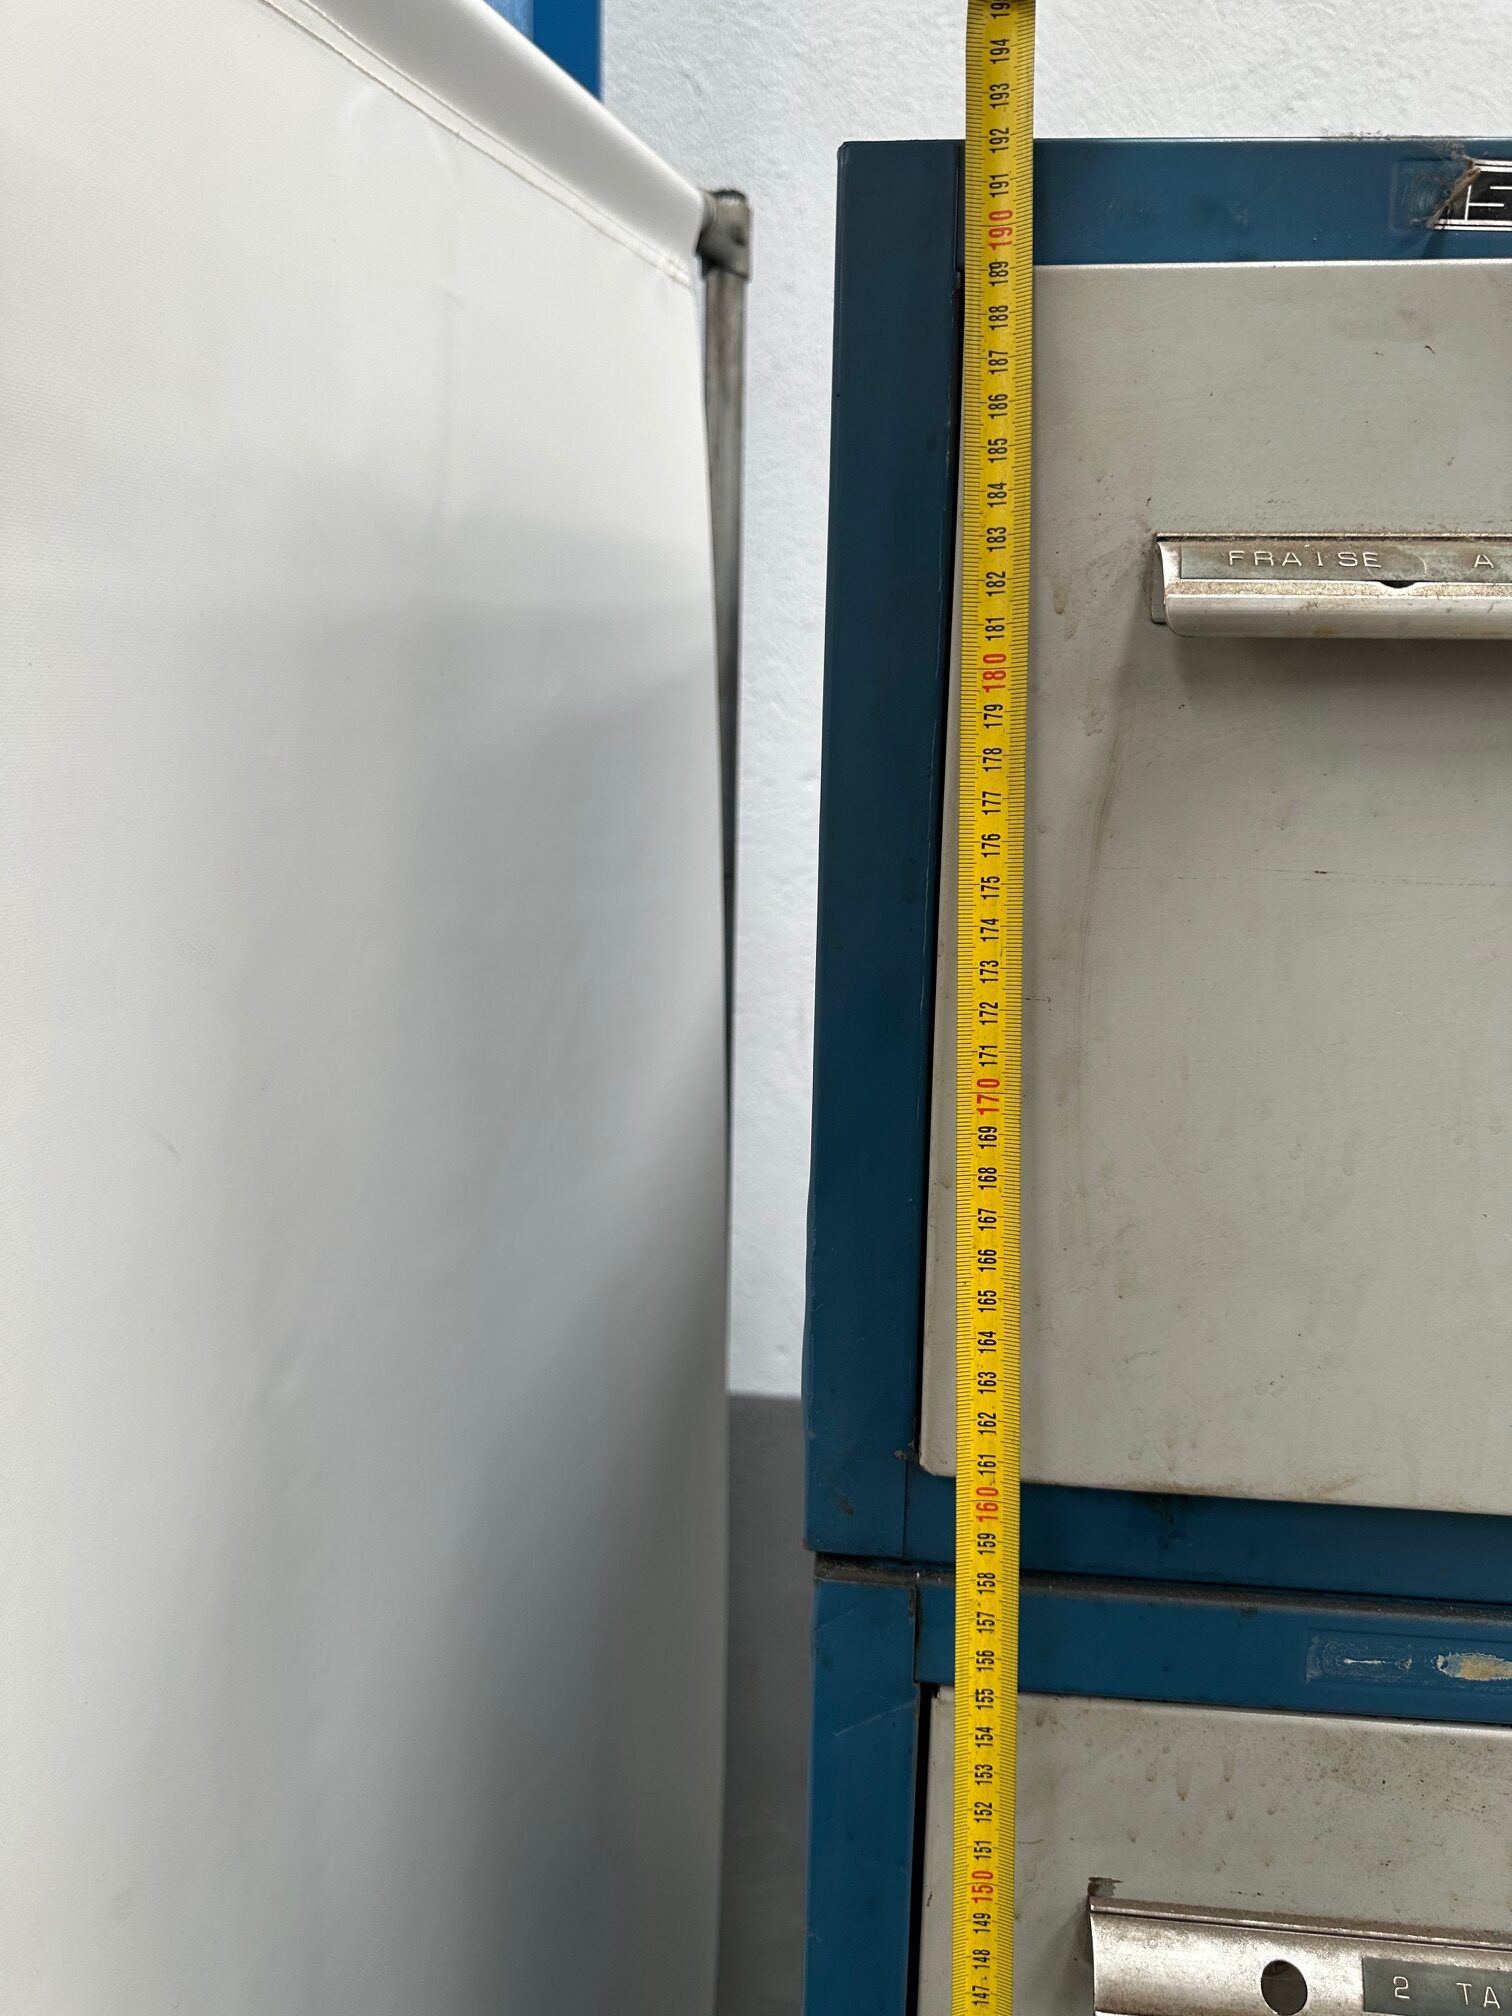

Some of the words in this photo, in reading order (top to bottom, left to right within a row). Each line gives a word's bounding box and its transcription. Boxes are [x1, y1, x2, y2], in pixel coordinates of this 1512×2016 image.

[990, 1, 1011, 20] 19
[989, 38, 1010, 65] 194
[989, 82, 1010, 110] 193
[988, 127, 1010, 154] 192
[988, 173, 1010, 199] 191
[988, 210, 1013, 250] 190
[988, 261, 1009, 287] 189
[988, 305, 1009, 331] 188
[988, 349, 1009, 376] 187
[987, 393, 1009, 420] 186
[987, 437, 1008, 464] 185
[986, 482, 1008, 509] 184
[986, 526, 1007, 553] 183
[1228, 551, 1382, 569] FRAISE
[1473, 554, 1495, 569] A
[985, 571, 1006, 598] 182
[984, 617, 1006, 642] 181
[982, 653, 1007, 693] 180
[983, 703, 1004, 730] 179
[982, 747, 1003, 773] 178
[981, 790, 1002, 816] 177
[980, 833, 1002, 858] 176
[980, 875, 1001, 900] 175
[979, 917, 1000, 943] 174
[979, 959, 1000, 984] 173
[978, 1001, 999, 1026] 172
[978, 1045, 998, 1068] 171
[976, 1078, 1001, 1116] 170
[977, 1125, 998, 1150] 169
[977, 1167, 998, 1191] 168
[977, 1207, 998, 1232] 167
[977, 1248, 998, 1273] 166
[977, 1289, 997, 1313] 165
[977, 1330, 997, 1354] 164
[977, 1371, 997, 1395] 163
[977, 1411, 997, 1435] 162
[977, 1454, 997, 1476] 161
[975, 1486, 999, 1522] 160
[976, 1532, 996, 1556] 159
[976, 1572, 996, 1595] 158
[976, 1611, 996, 1634] 157
[975, 1650, 995, 1672] 156
[974, 1688, 995, 1710] 155
[974, 1726, 994, 1748] 154
[974, 1764, 994, 1786] 153
[973, 1801, 993, 1823] 152
[973, 1840, 992, 1861] 151
[971, 1870, 994, 1904] 150
[972, 1912, 991, 1934] 149
[972, 1948, 991, 1970] 148
[971, 1985, 990, 2006] 147
[1393, 1976, 1410, 1999] 2
